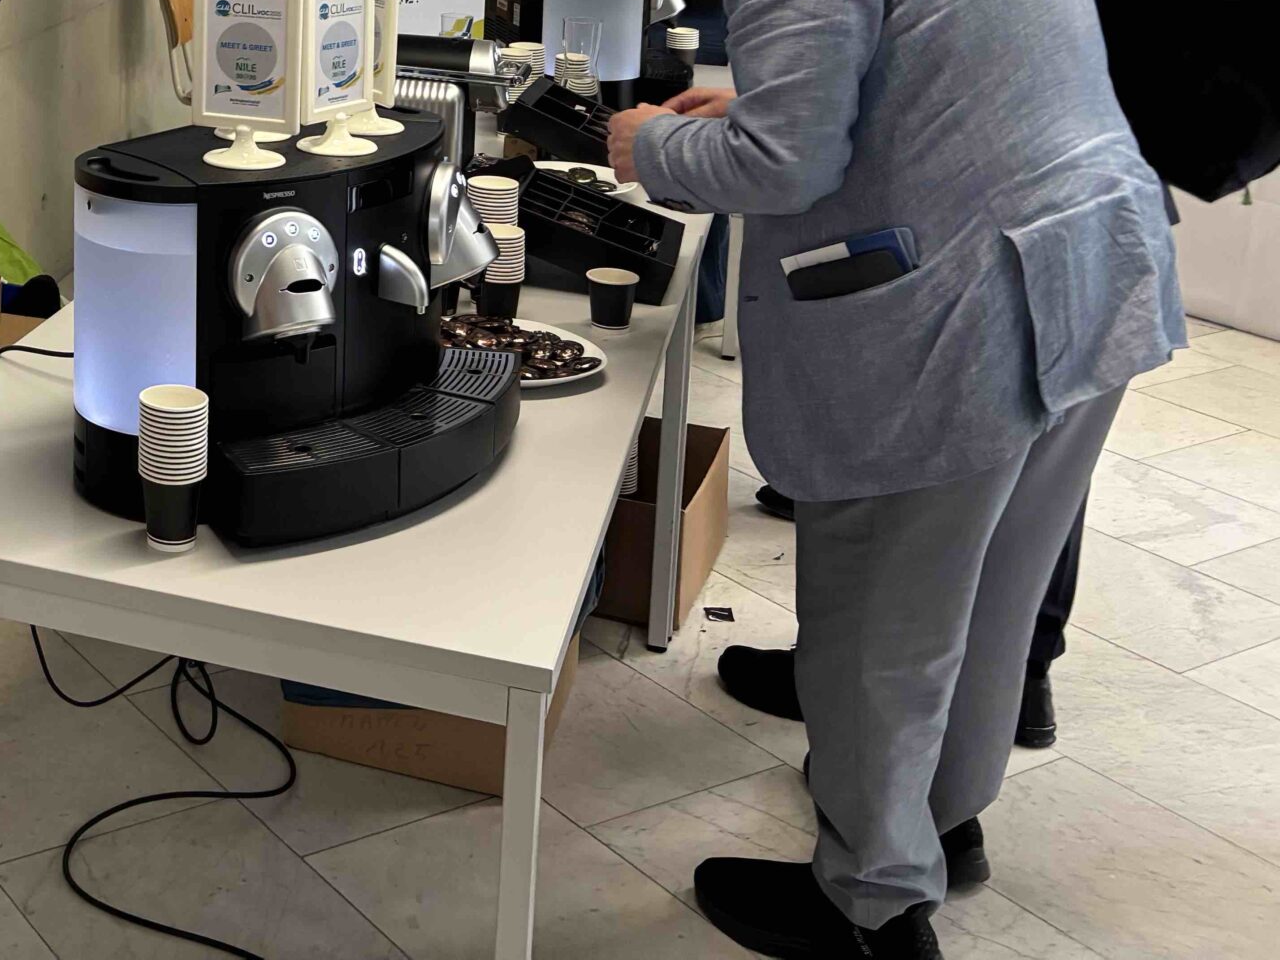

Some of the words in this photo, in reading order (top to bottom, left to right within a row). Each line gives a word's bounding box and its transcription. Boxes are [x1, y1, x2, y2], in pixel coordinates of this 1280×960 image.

[220, 41, 240, 49] MEET
[248, 44, 273, 52] GREET
[322, 42, 336, 51] MEET
[235, 62, 257, 73] NILE
[263, 190, 295, 200] NESPRESSO
